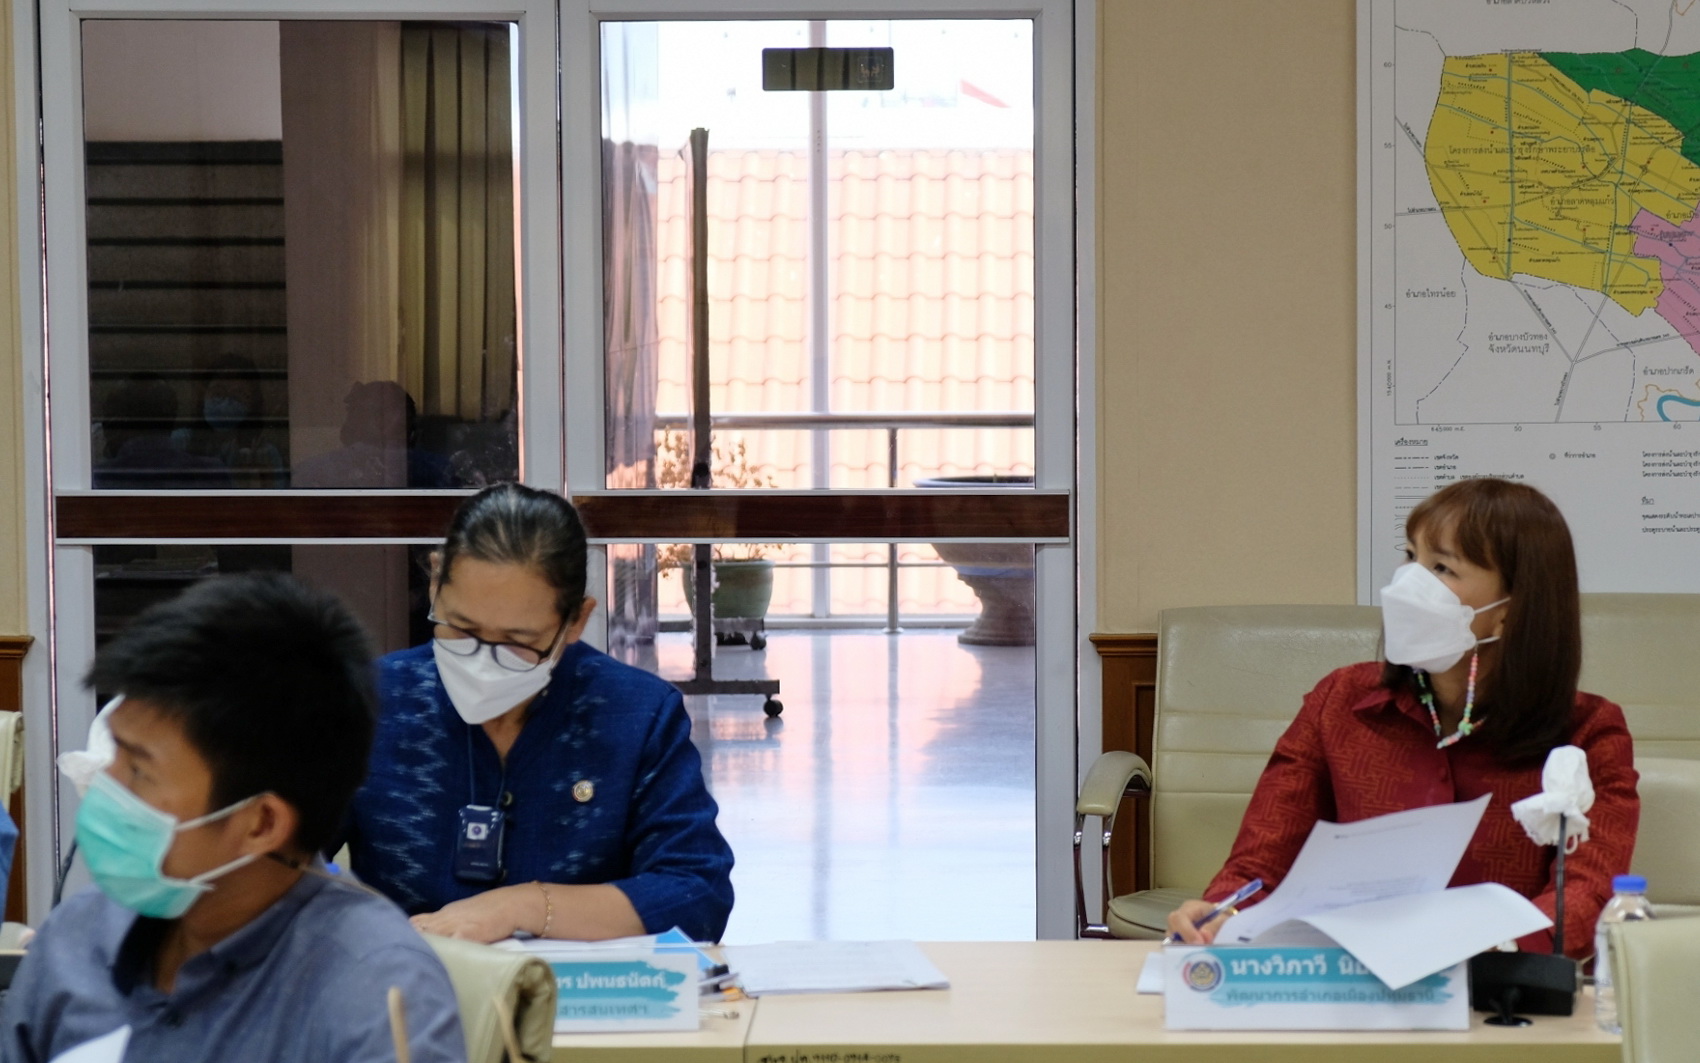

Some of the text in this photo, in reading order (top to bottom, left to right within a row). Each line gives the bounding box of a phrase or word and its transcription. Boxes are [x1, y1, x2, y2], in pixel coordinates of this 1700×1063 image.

[1405, 286, 1457, 299] อำเภอไทรน้อย
[1488, 331, 1548, 343] อำเภอบางบัวทอง
[1488, 342, 1550, 356] จังหวัดนนทบุรี
[1642, 365, 1695, 376] อำเภอปากเกร็ด
[1592, 424, 1602, 432] 55
[1230, 952, 1328, 976] นางวิภาวี
